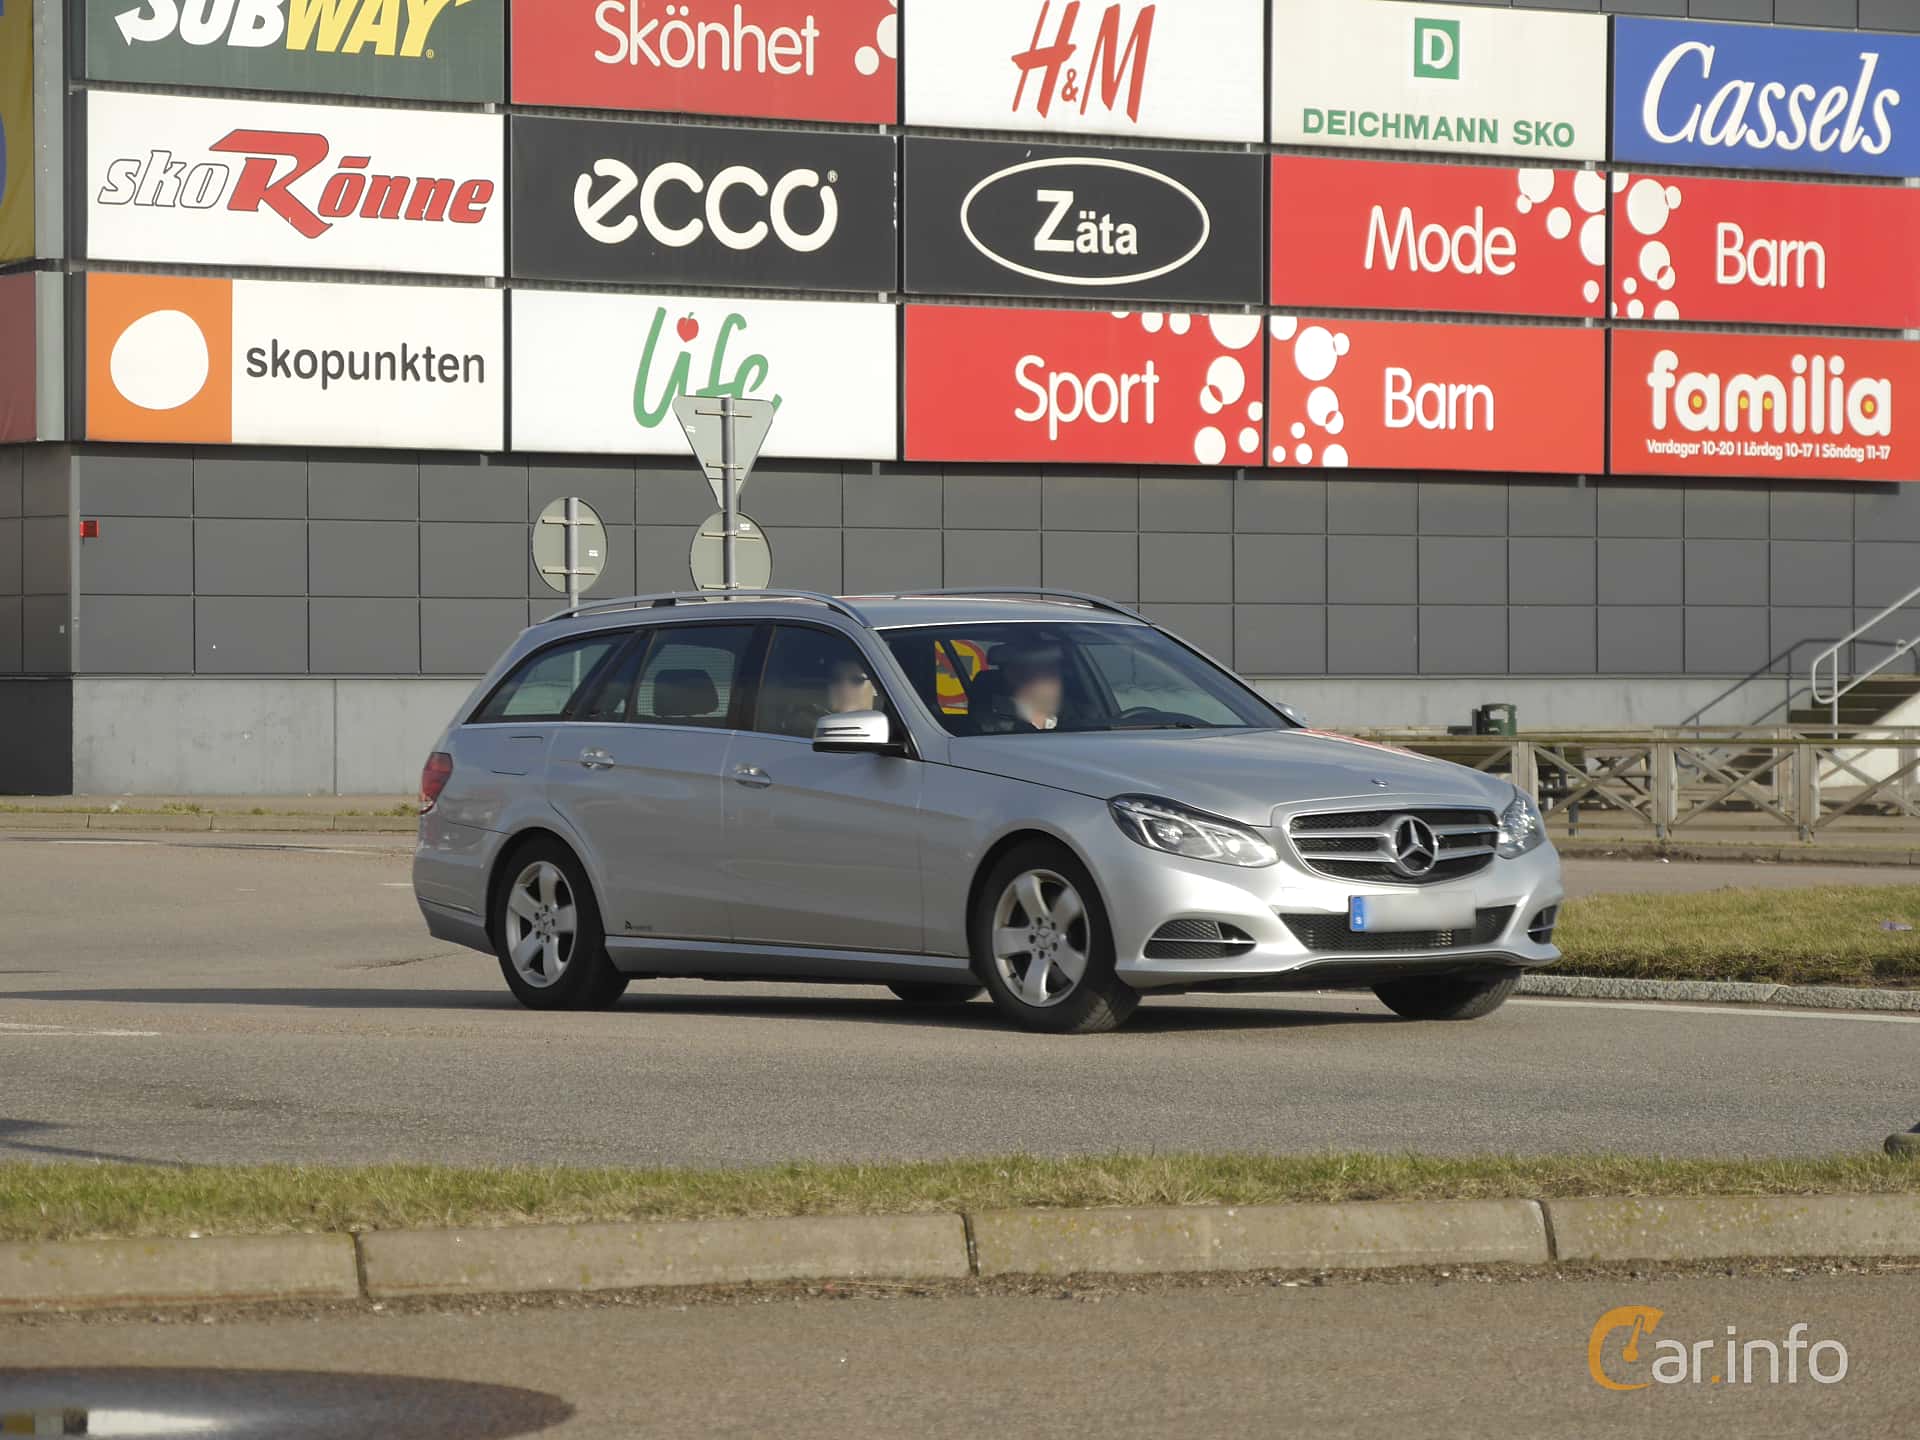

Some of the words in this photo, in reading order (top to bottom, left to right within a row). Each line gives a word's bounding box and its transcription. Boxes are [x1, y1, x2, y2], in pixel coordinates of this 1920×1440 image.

[114, 0, 446, 57] SUBWAY
[594, 0, 820, 76] Skönhet
[1011, 0, 1156, 123] H&M
[1421, 27, 1454, 70] D
[1303, 109, 1499, 145] DEICHMANN
[1512, 120, 1575, 148] SKO
[1642, 41, 1900, 155] Cassels
[1033, 189, 1138, 255] Zäta
[1363, 204, 1517, 276] Mode
[1716, 222, 1826, 289] Barn
[246, 338, 485, 391] skopunkten
[1014, 354, 1160, 441] Sport
[1646, 349, 1892, 437] familia
[1384, 367, 1494, 431] Barn
[1647, 439, 1700, 457] Vardagar
[1702, 441, 1735, 456] 10-20
[1744, 442, 1784, 460] Lördag
[1785, 444, 1813, 458] 10-17
[1822, 444, 1865, 462] Söndag
[1866, 445, 1891, 460] 11-17
